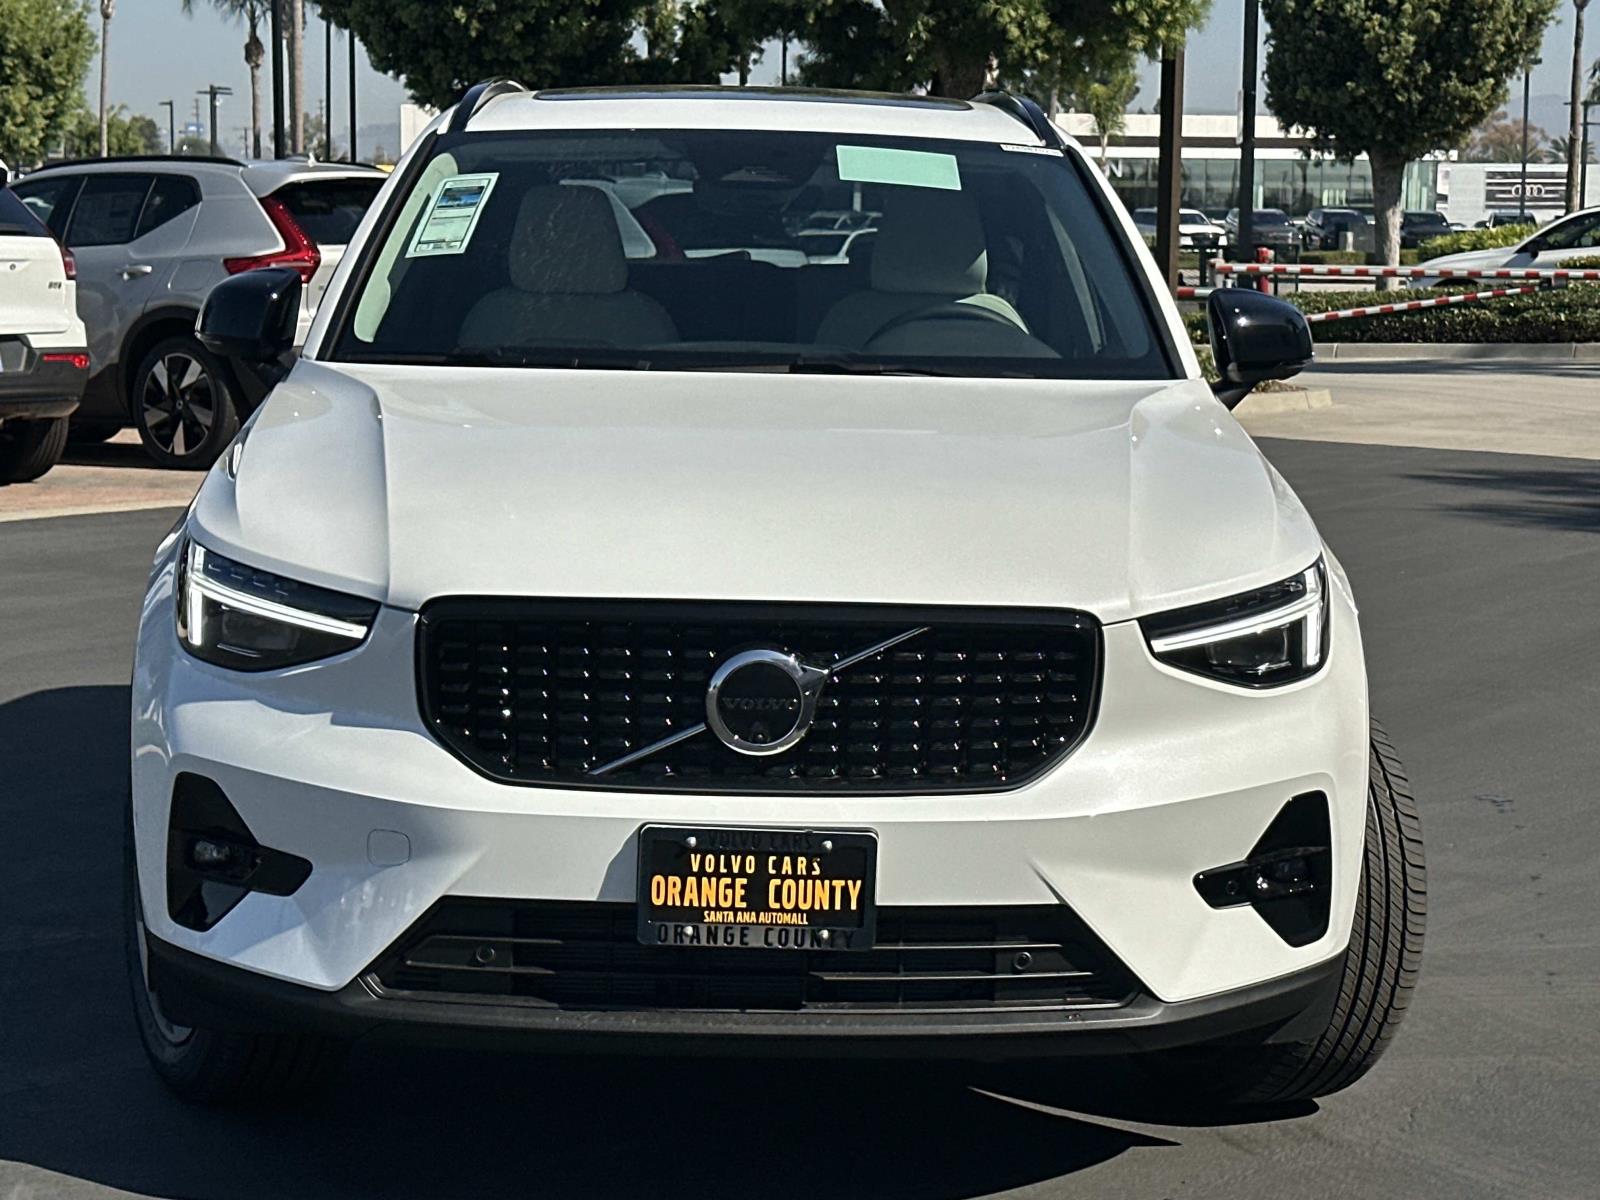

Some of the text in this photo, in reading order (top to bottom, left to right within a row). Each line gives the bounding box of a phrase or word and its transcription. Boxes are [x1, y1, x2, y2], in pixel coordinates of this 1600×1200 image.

[721, 697, 798, 710] VOLVO
[708, 831, 812, 851] VOLVO CARS
[690, 853, 821, 876] VOLVO CARS
[651, 874, 862, 911] ORANGE COUNTY
[703, 910, 809, 925] SANTA ANA AUTOMALL
[657, 923, 857, 948] ORANGE COUNTY
